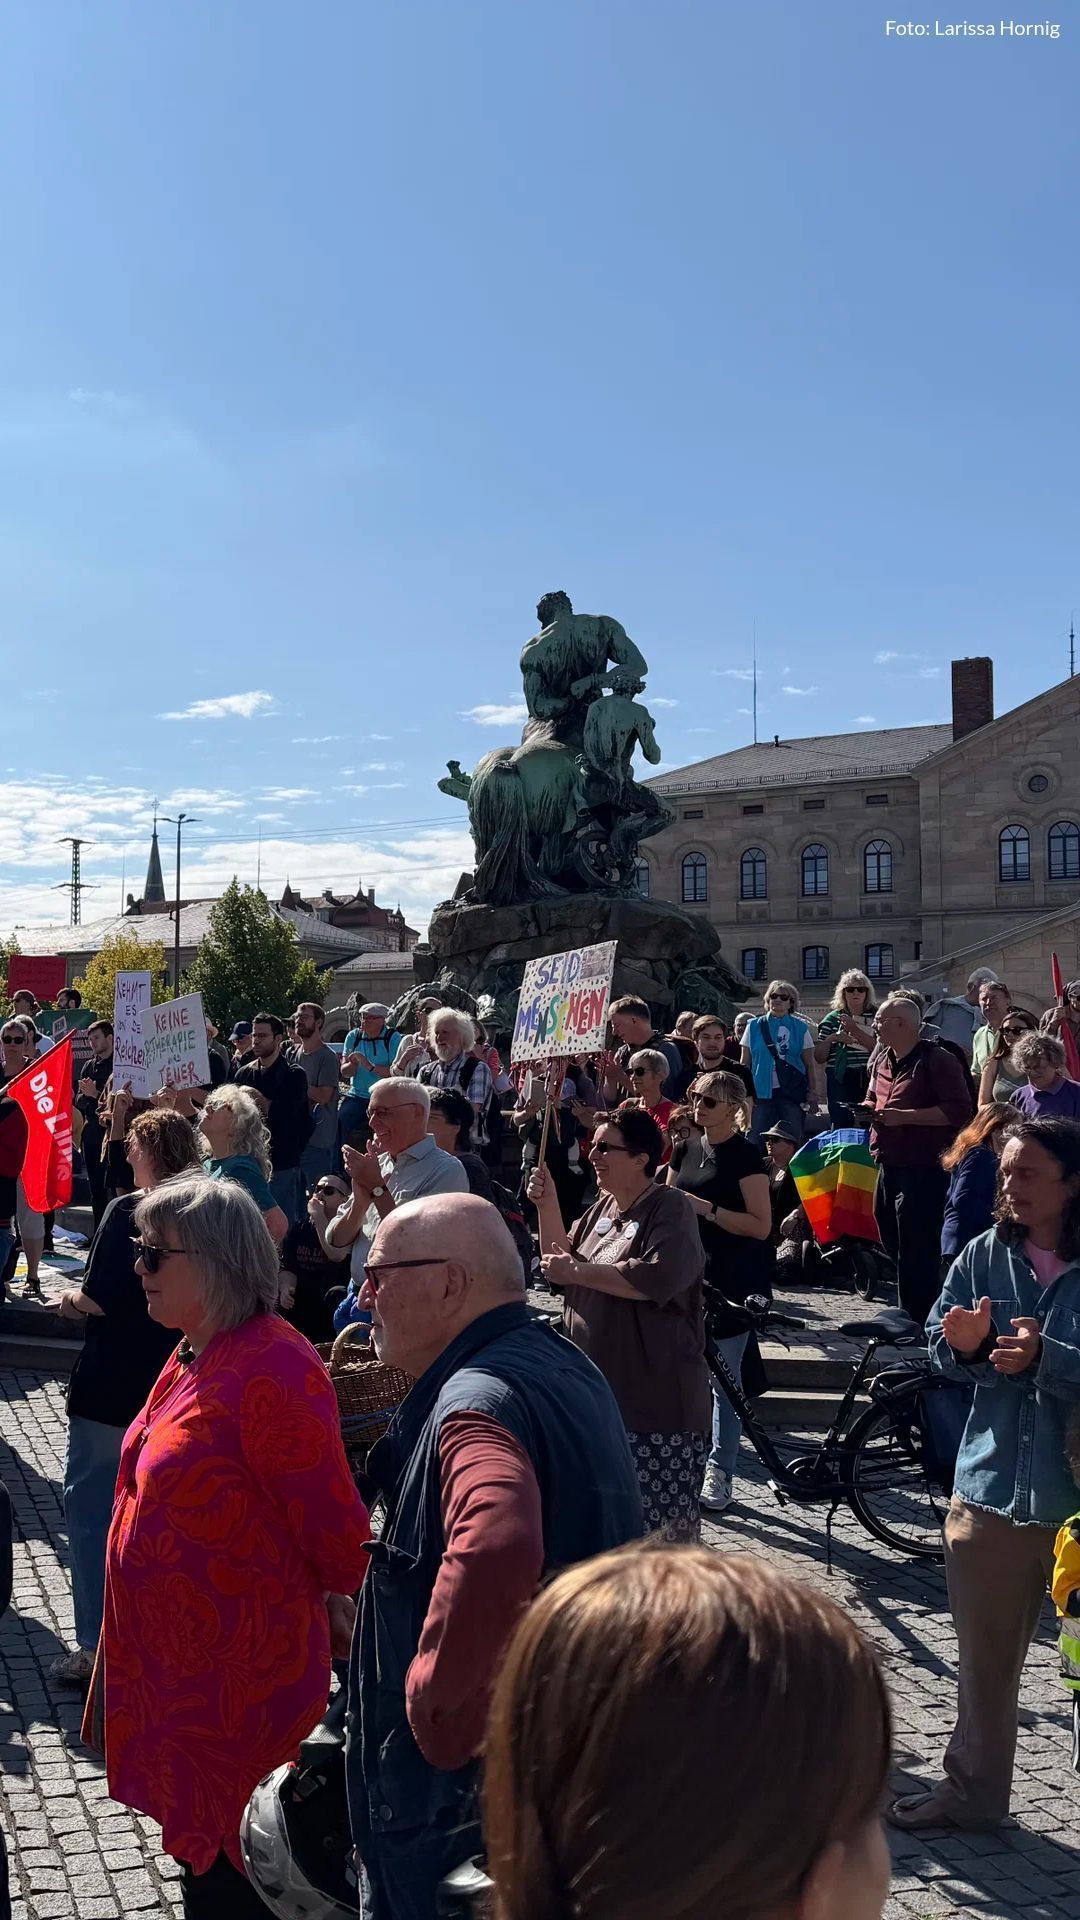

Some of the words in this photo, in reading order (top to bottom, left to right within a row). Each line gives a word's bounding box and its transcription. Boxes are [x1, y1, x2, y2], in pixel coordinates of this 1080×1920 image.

[534, 952, 581, 990] SEID
[116, 980, 147, 1003] NEHMT
[125, 1005, 137, 1016] ES
[154, 1008, 190, 1034] KEINE
[514, 986, 608, 1048] MENSCHEN
[158, 1061, 202, 1086] TEUER
[29, 1070, 55, 1114] Die
